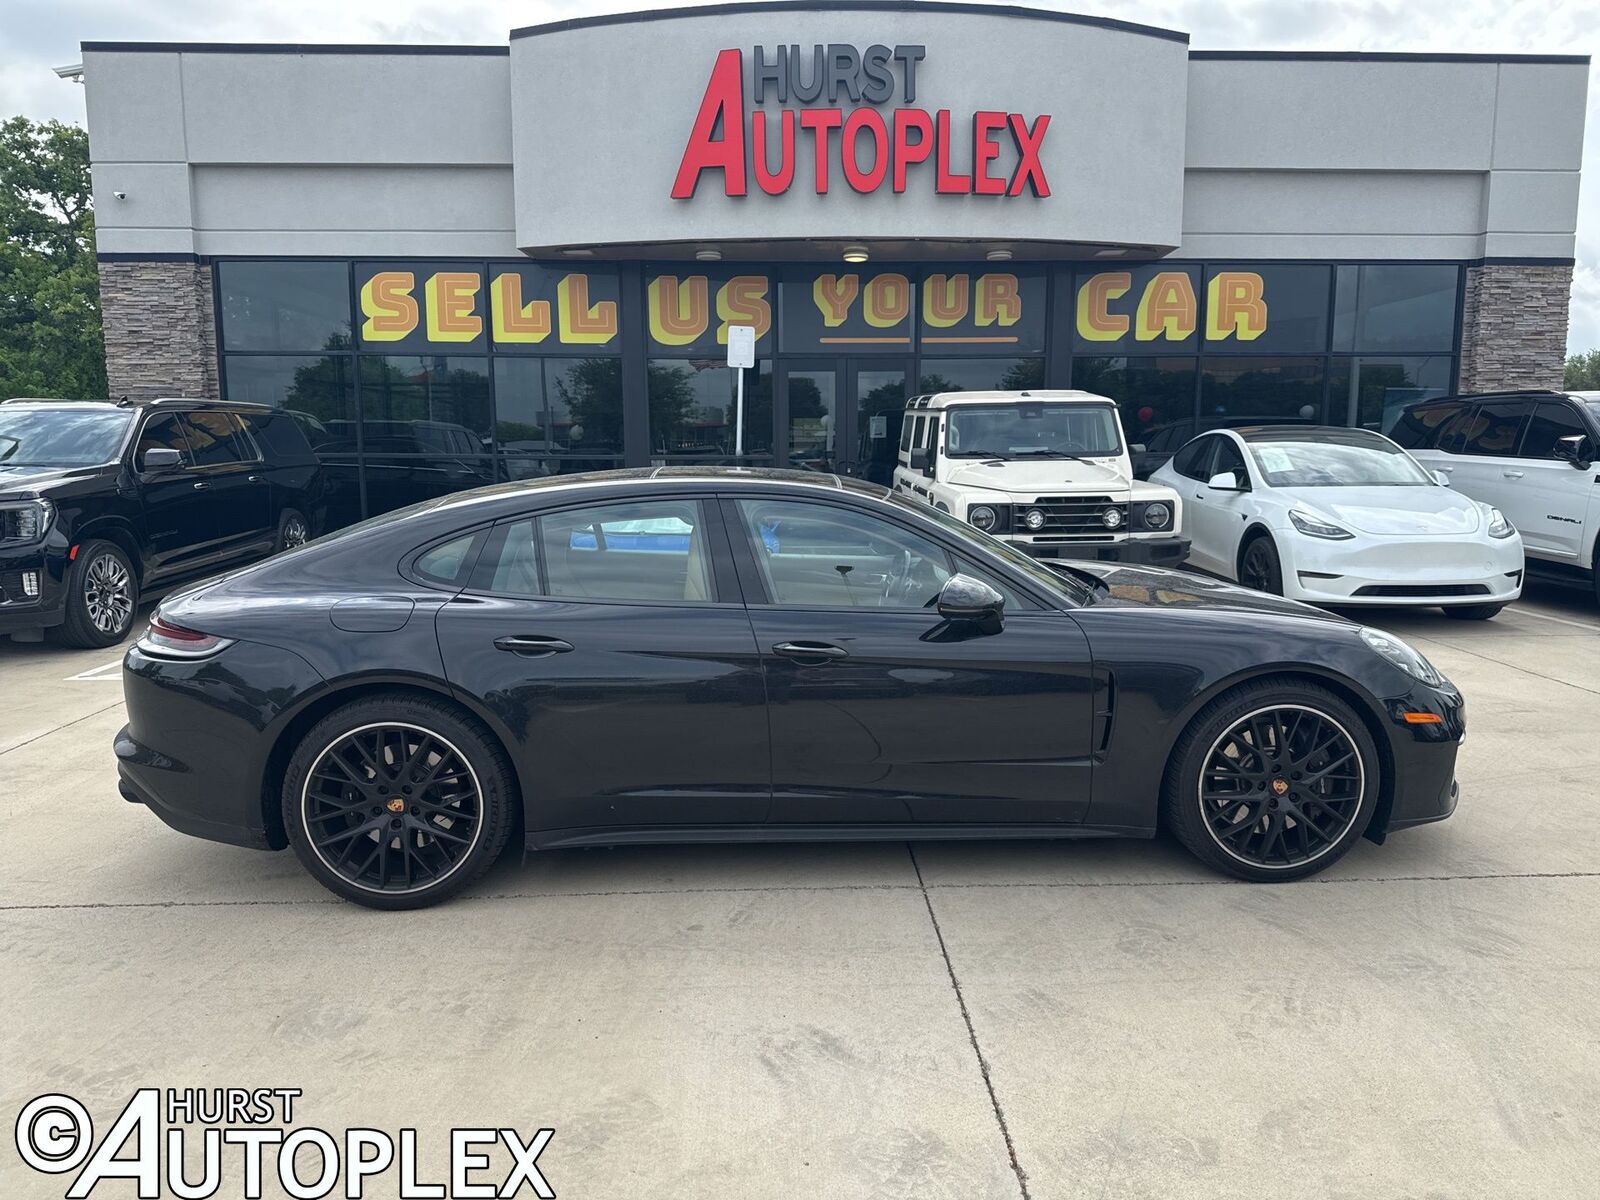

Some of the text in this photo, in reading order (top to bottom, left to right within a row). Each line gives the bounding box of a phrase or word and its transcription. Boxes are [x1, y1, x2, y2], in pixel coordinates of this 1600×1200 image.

[753, 44, 927, 104] HURST
[670, 48, 1052, 199] AUTOPLEX
[360, 271, 1268, 346] SELL US YOUR CAR
